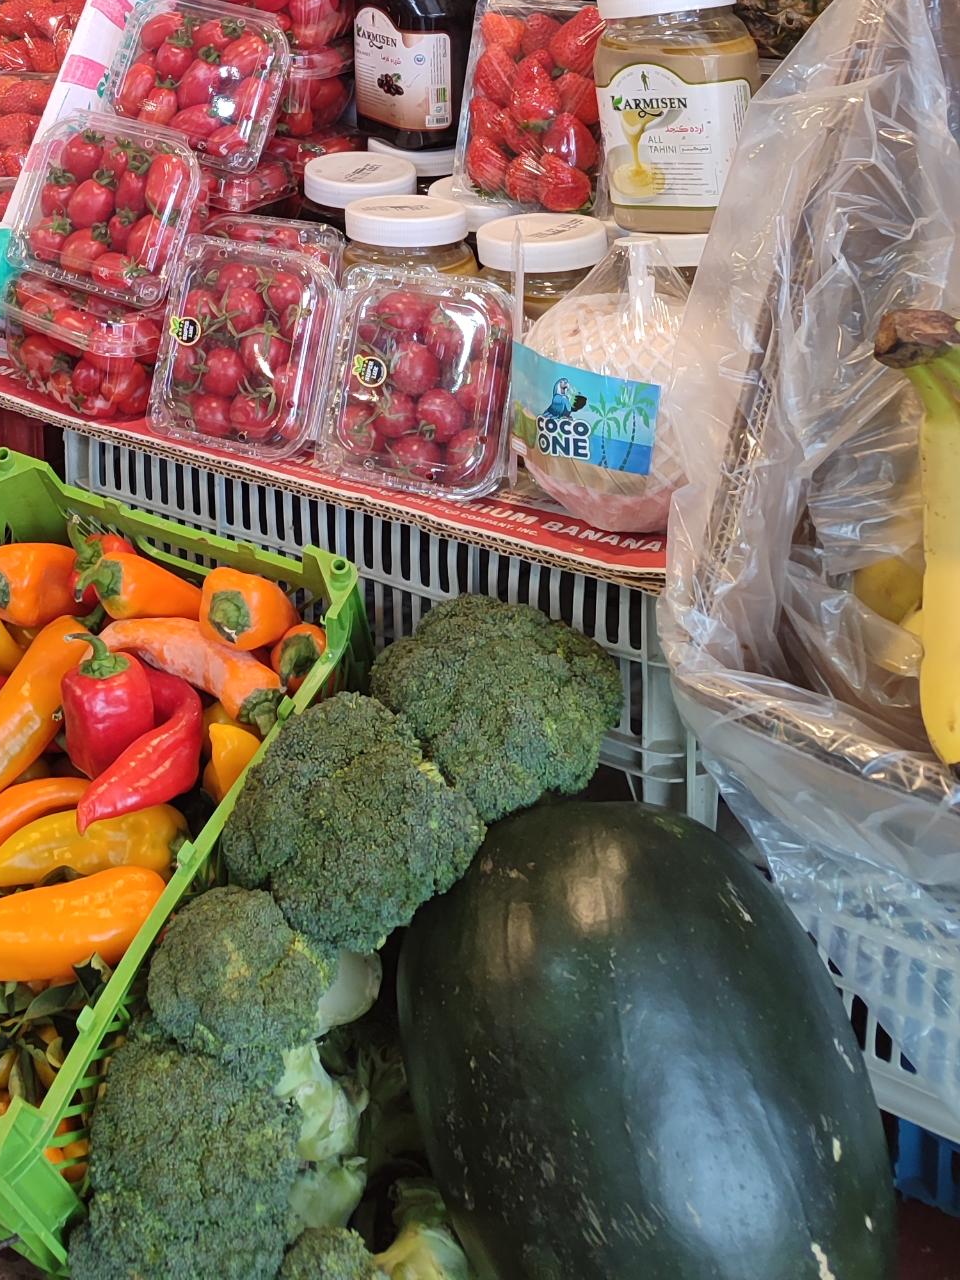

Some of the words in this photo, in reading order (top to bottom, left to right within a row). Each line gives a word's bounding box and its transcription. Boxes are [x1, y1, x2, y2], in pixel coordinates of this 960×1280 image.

[356, 23, 397, 50] KARMISEN
[610, 95, 688, 119] KARMISEN
[648, 135, 664, 144] ALL
[665, 125, 689, 134] کنجد
[690, 123, 704, 135] ارده
[648, 145, 677, 154] TAHINI
[537, 417, 590, 437] COCO
[538, 433, 589, 458] ONE
[406, 496, 431, 510] DOLE
[432, 504, 460, 517] FOOD
[460, 512, 515, 532] COMPANY,
[516, 527, 540, 538] INC.
[455, 500, 540, 526] MIUM
[540, 520, 667, 553] BANANA
